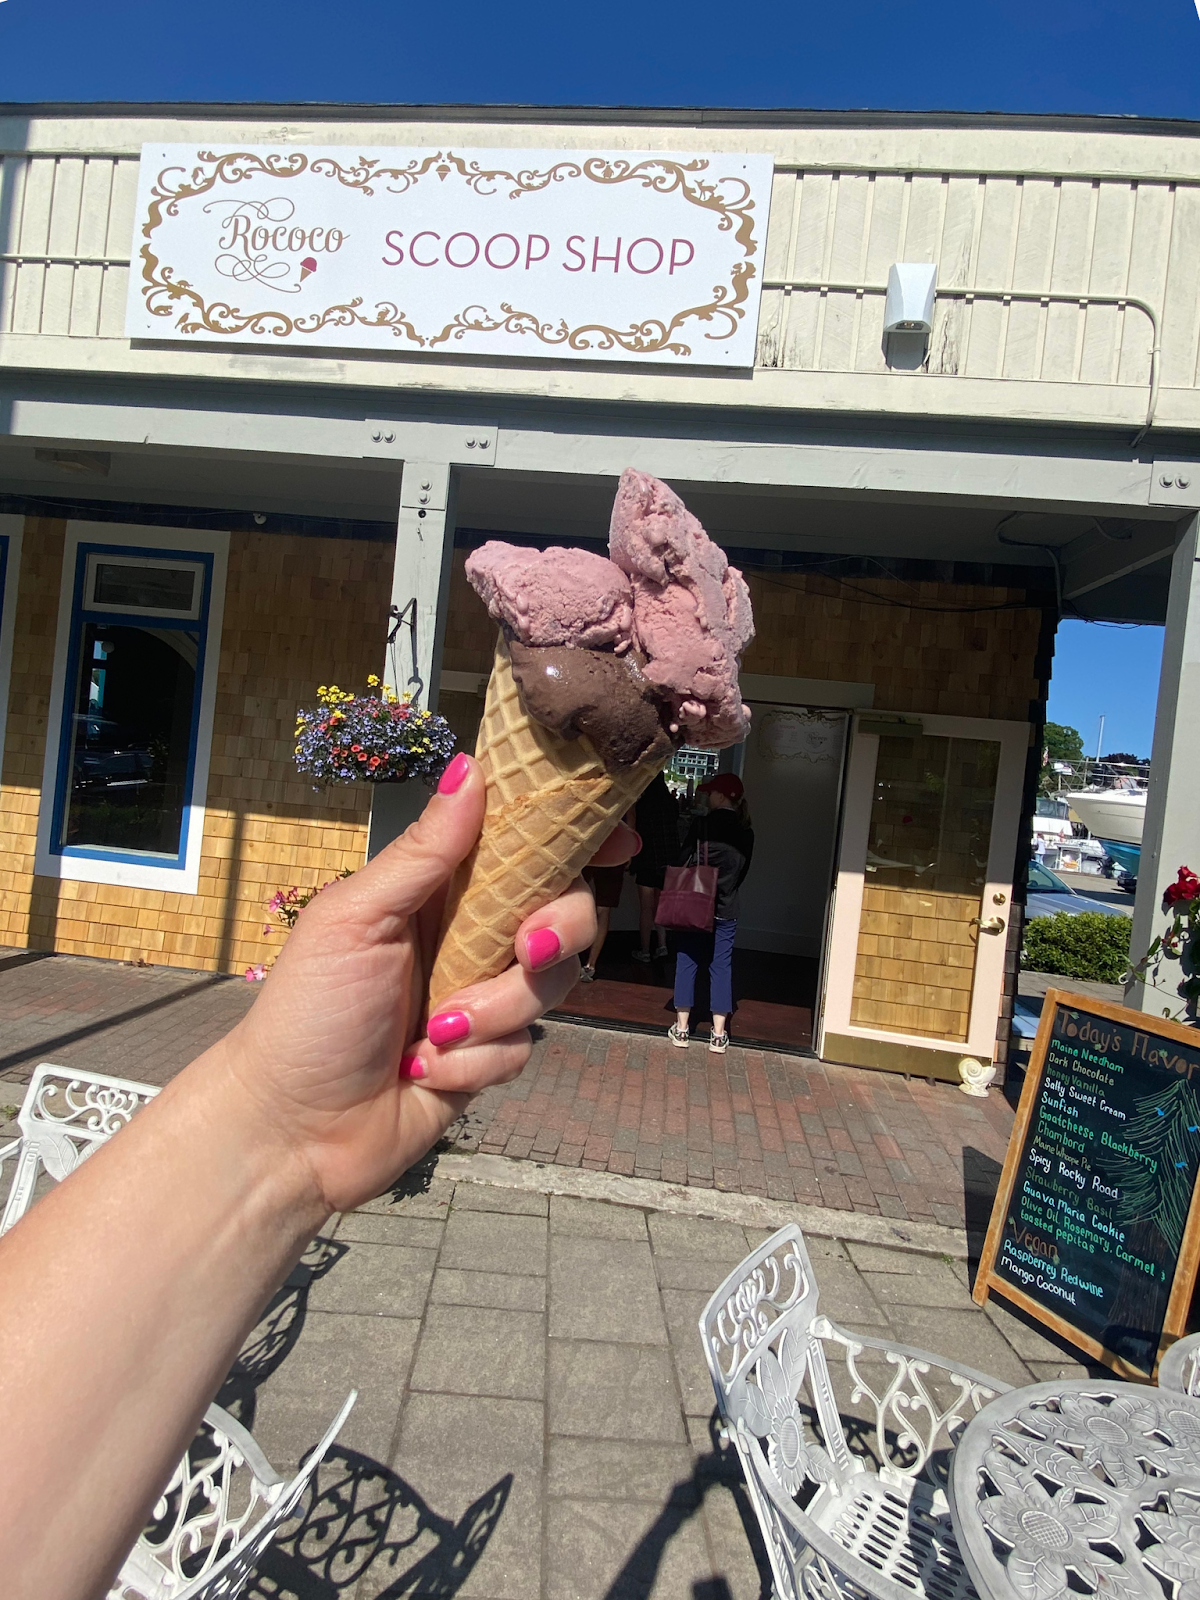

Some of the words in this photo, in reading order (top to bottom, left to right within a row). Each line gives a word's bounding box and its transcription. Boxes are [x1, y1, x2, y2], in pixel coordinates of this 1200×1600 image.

[215, 205, 351, 263] Rococo
[381, 230, 550, 270] SCOOP
[562, 235, 695, 275] SHOP
[1059, 1010, 1122, 1053] Today's
[1048, 1052, 1068, 1068] Dark
[1072, 1060, 1115, 1086] Chocolate
[1051, 1039, 1079, 1057] Maine
[1081, 1048, 1124, 1074] Needham
[1041, 1091, 1079, 1118] Sunfish
[1069, 1086, 1097, 1107] Sweet
[1100, 1100, 1126, 1121] Cream
[1072, 1075, 1105, 1098] Vanilla
[1033, 1135, 1055, 1154] Maine
[1081, 1156, 1092, 1172] Pie
[1038, 1120, 1085, 1153] Chambord
[1101, 1131, 1158, 1174] Blackberry
[1026, 1166, 1079, 1206] Strawberry
[1087, 1197, 1112, 1220] Basil
[1029, 1148, 1051, 1174] Spicy
[1058, 1161, 1086, 1190] Rocky
[1092, 1175, 1119, 1199] Road
[1020, 1209, 1053, 1233] toasted
[1055, 1228, 1095, 1254] pepitas
[1023, 1180, 1055, 1208] Guava
[1057, 1199, 1086, 1223] Maria
[1092, 1214, 1125, 1243] Cookie
[1012, 1220, 1058, 1259] Vegan
[1021, 1195, 1043, 1215] Olive
[1115, 1244, 1155, 1277] Carmel
[1001, 1255, 1035, 1285] Mango
[1036, 1274, 1077, 1306] Coconut
